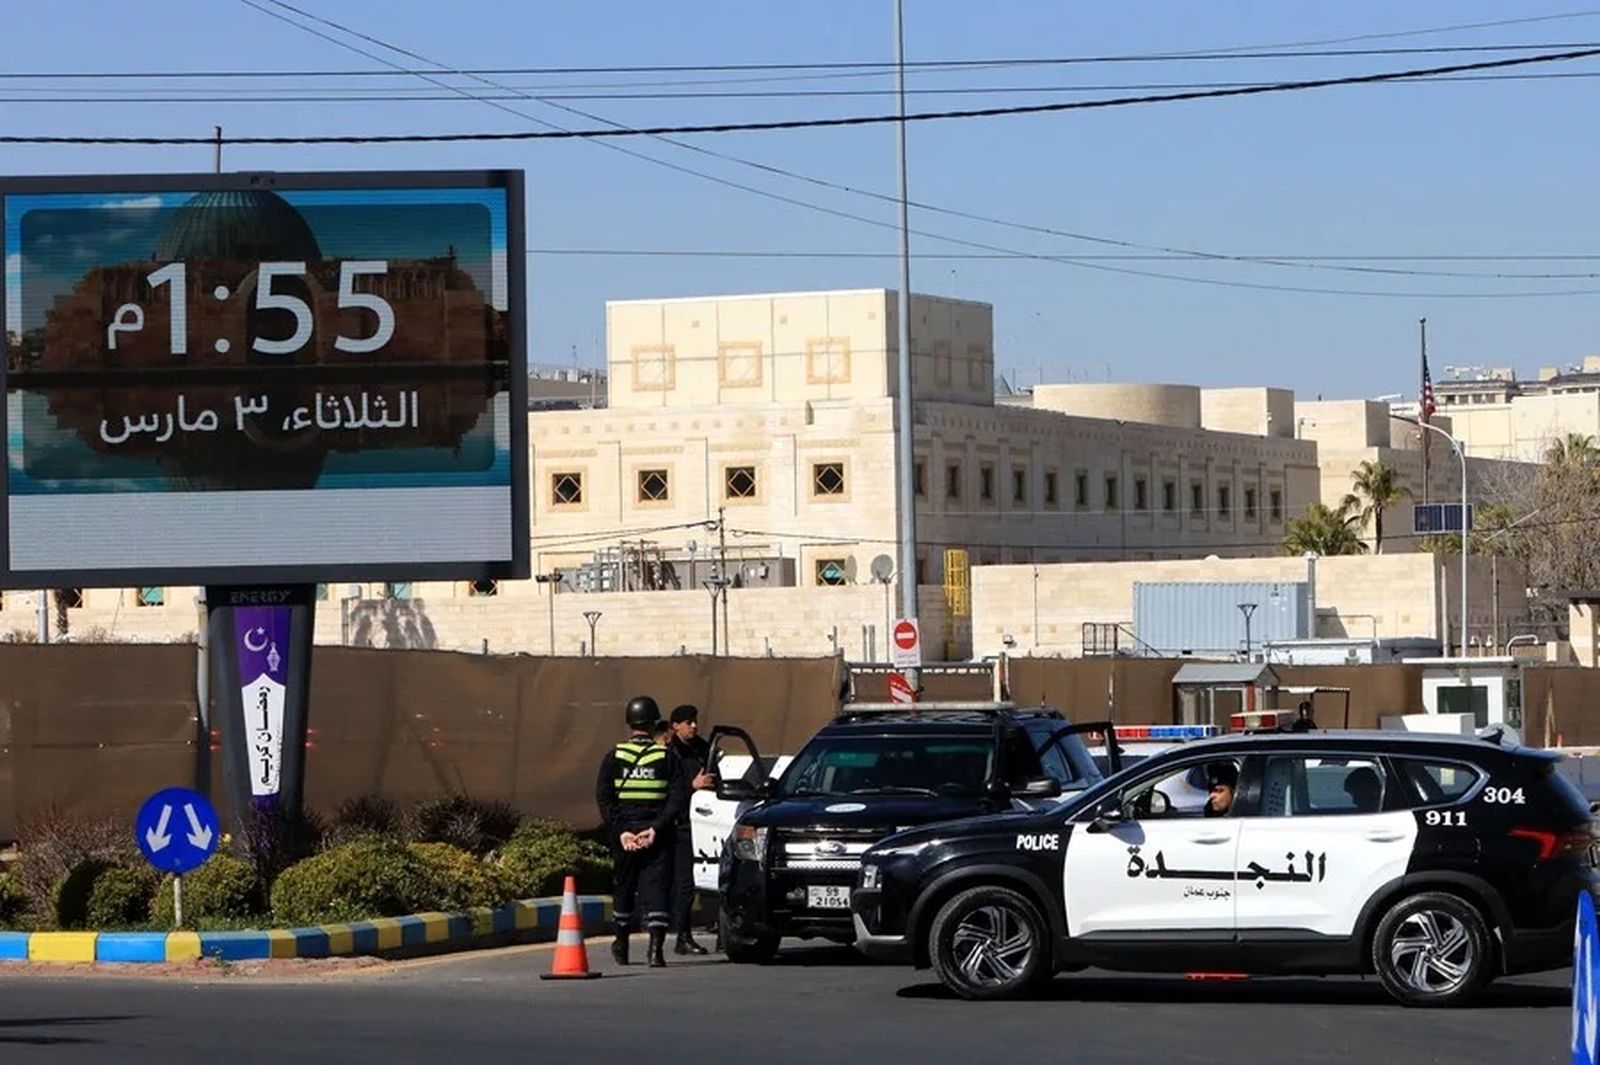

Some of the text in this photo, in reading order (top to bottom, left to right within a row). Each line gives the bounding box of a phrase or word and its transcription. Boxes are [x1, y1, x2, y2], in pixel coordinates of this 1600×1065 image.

[108, 261, 395, 354] 1:55 م
[100, 395, 218, 443] مارس
[234, 395, 268, 431] ٣
[1483, 786, 1526, 804] 304
[1425, 810, 1467, 826] 911
[1016, 833, 1059, 851] POLICE
